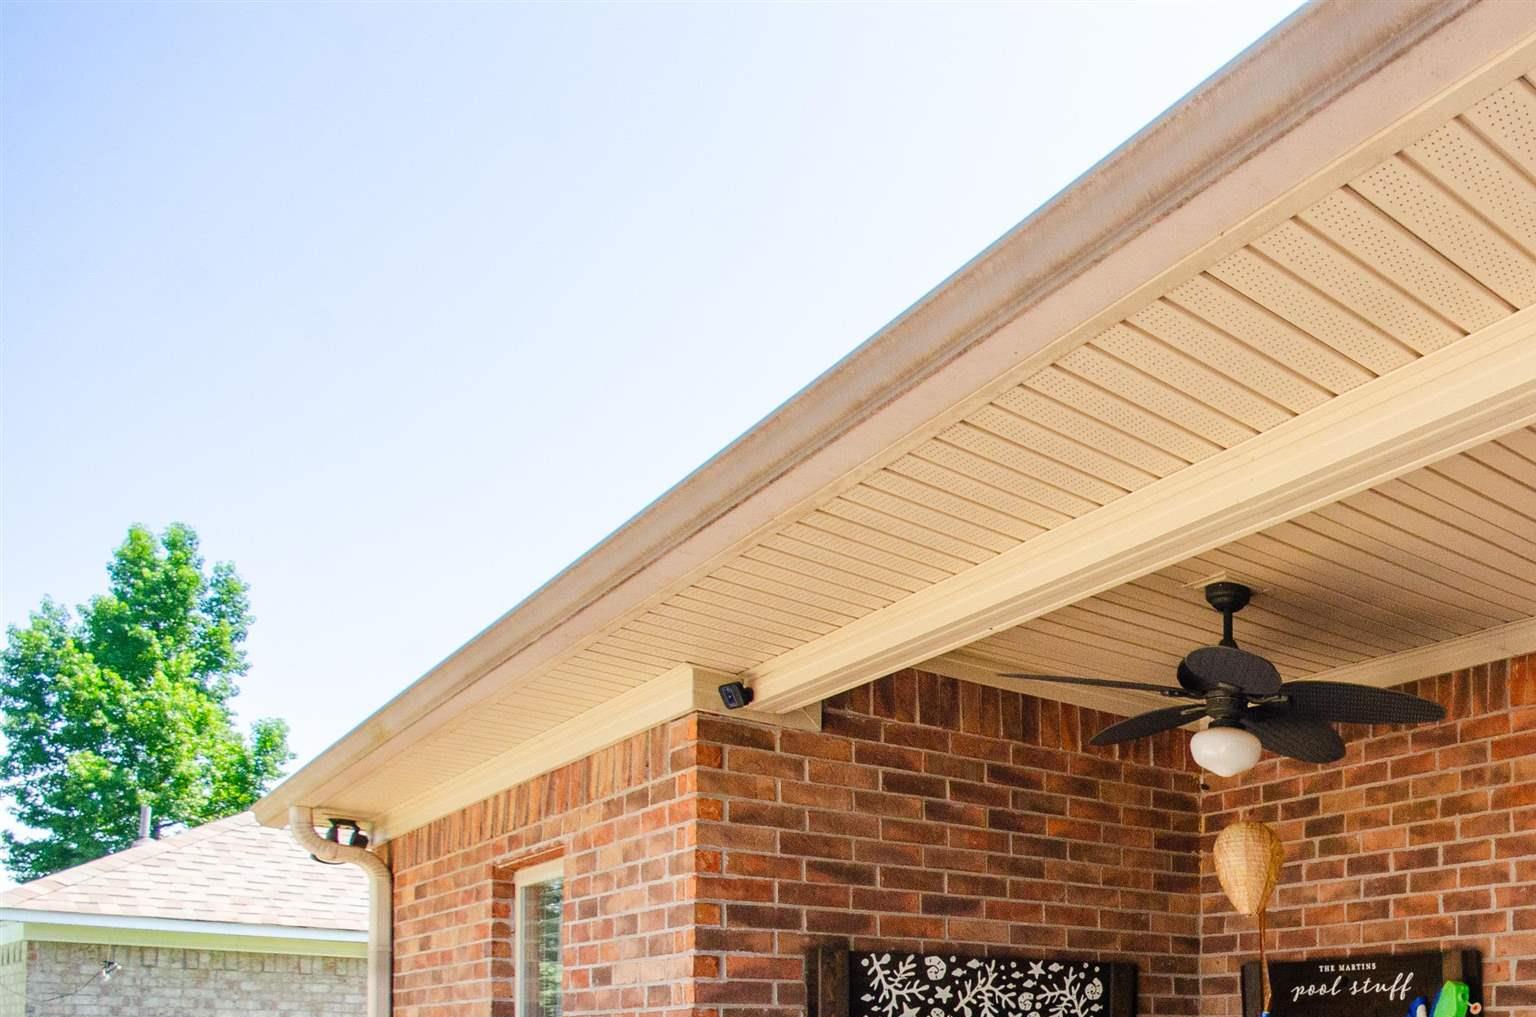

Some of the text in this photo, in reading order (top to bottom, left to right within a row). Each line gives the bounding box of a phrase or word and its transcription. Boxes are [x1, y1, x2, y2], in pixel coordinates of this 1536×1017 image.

[1319, 962, 1376, 973] THE MARTINS
[1291, 972, 1414, 1002] pool stuff
